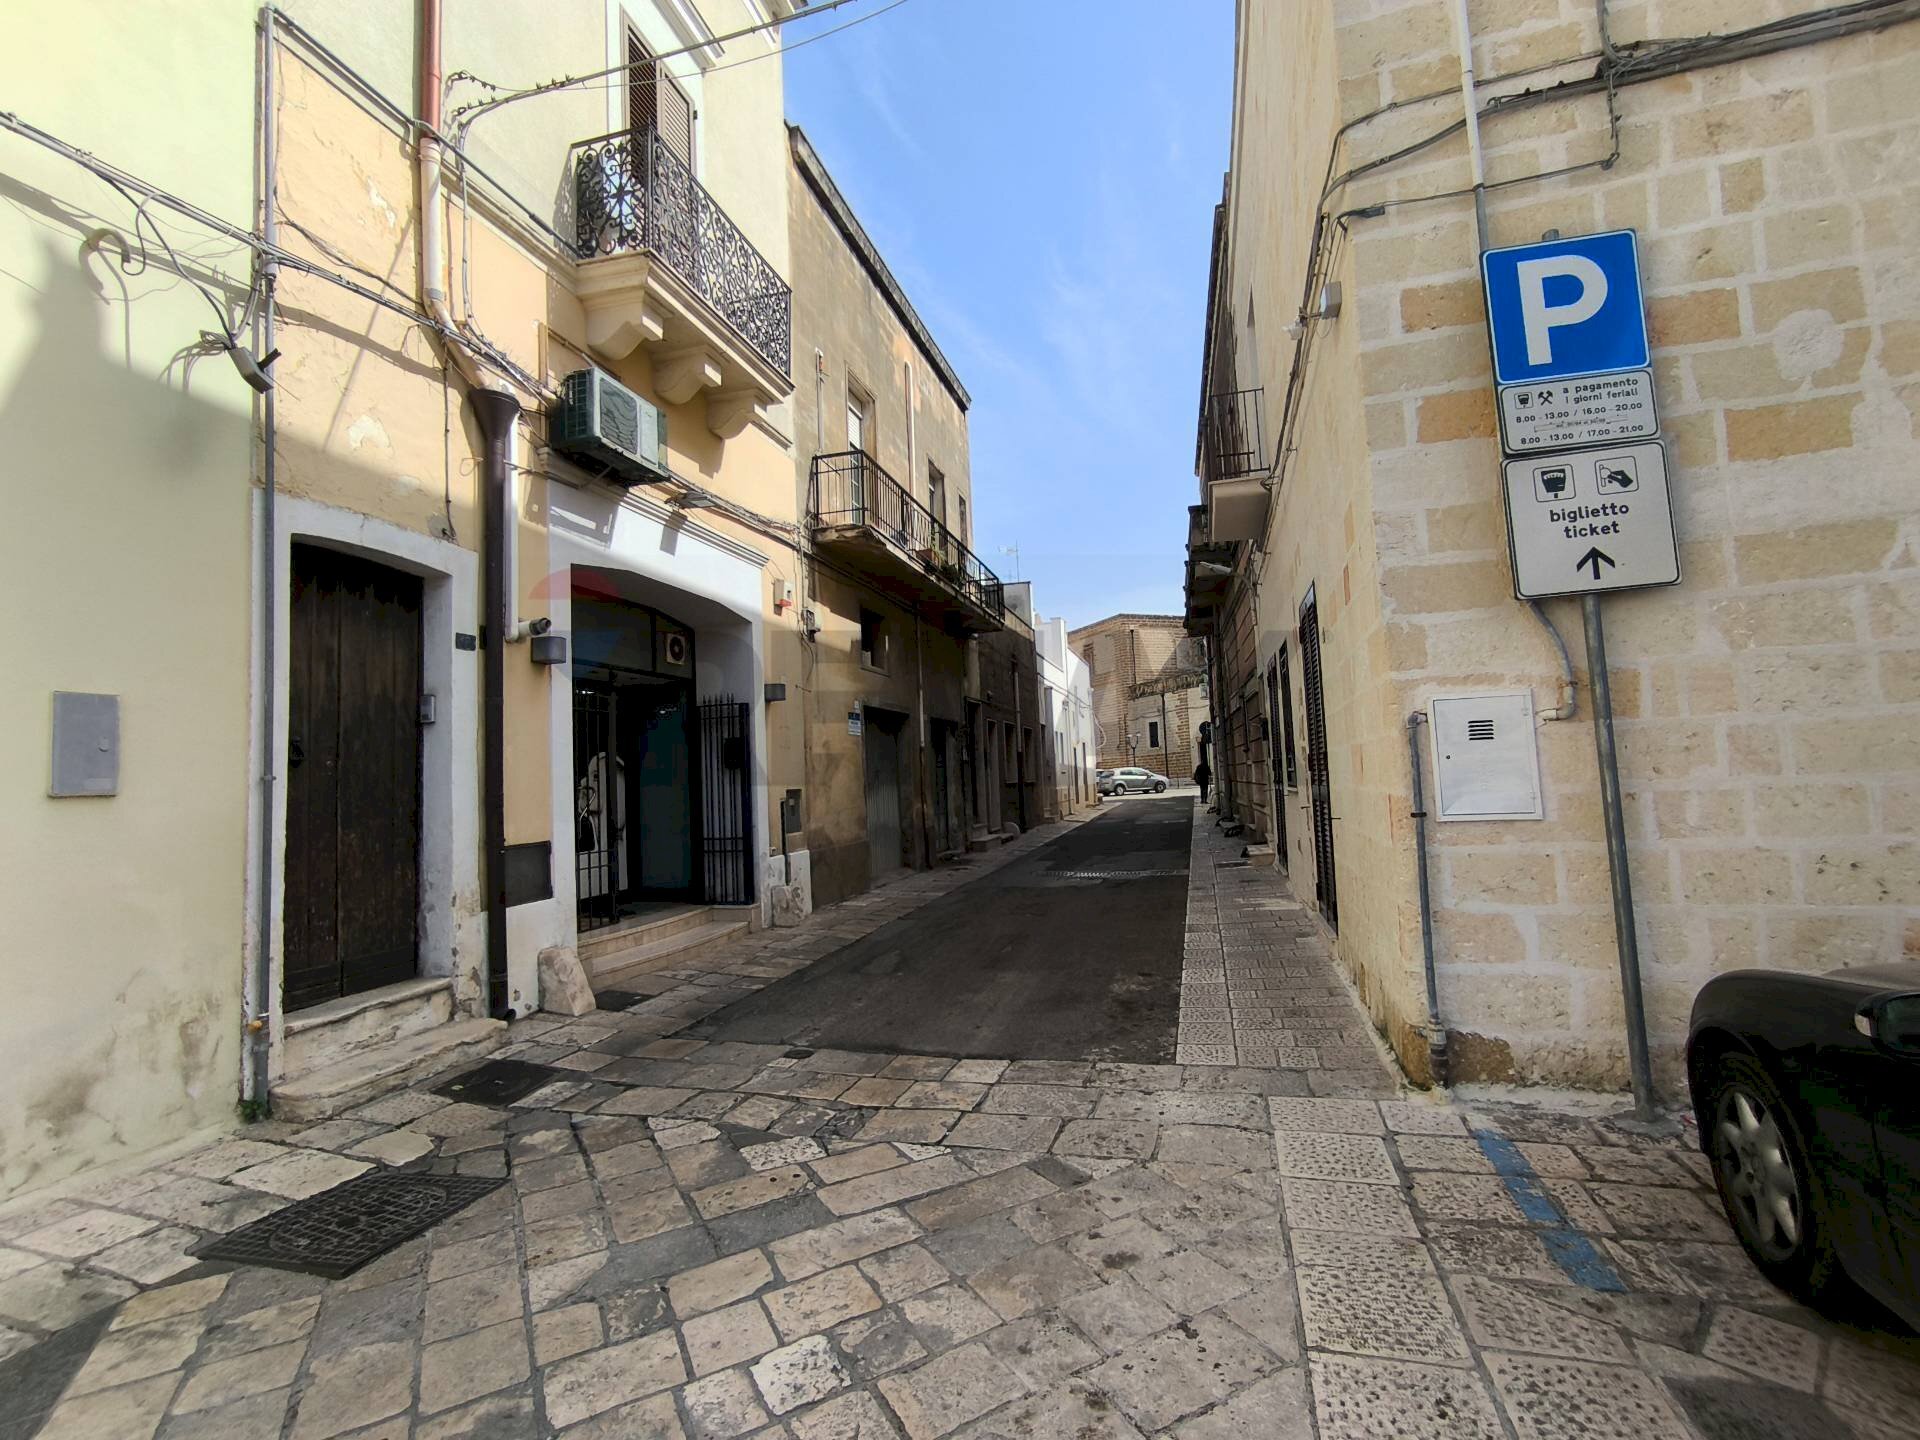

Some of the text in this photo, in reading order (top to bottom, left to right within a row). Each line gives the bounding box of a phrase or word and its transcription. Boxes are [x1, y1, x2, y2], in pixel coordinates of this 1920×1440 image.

[1517, 254, 1608, 366] P
[1575, 378, 1639, 394] pagamento
[1573, 392, 1602, 405] giorni
[1607, 387, 1639, 399] feriali
[1549, 502, 1629, 523] biglietto
[1564, 521, 1620, 539] ticket
